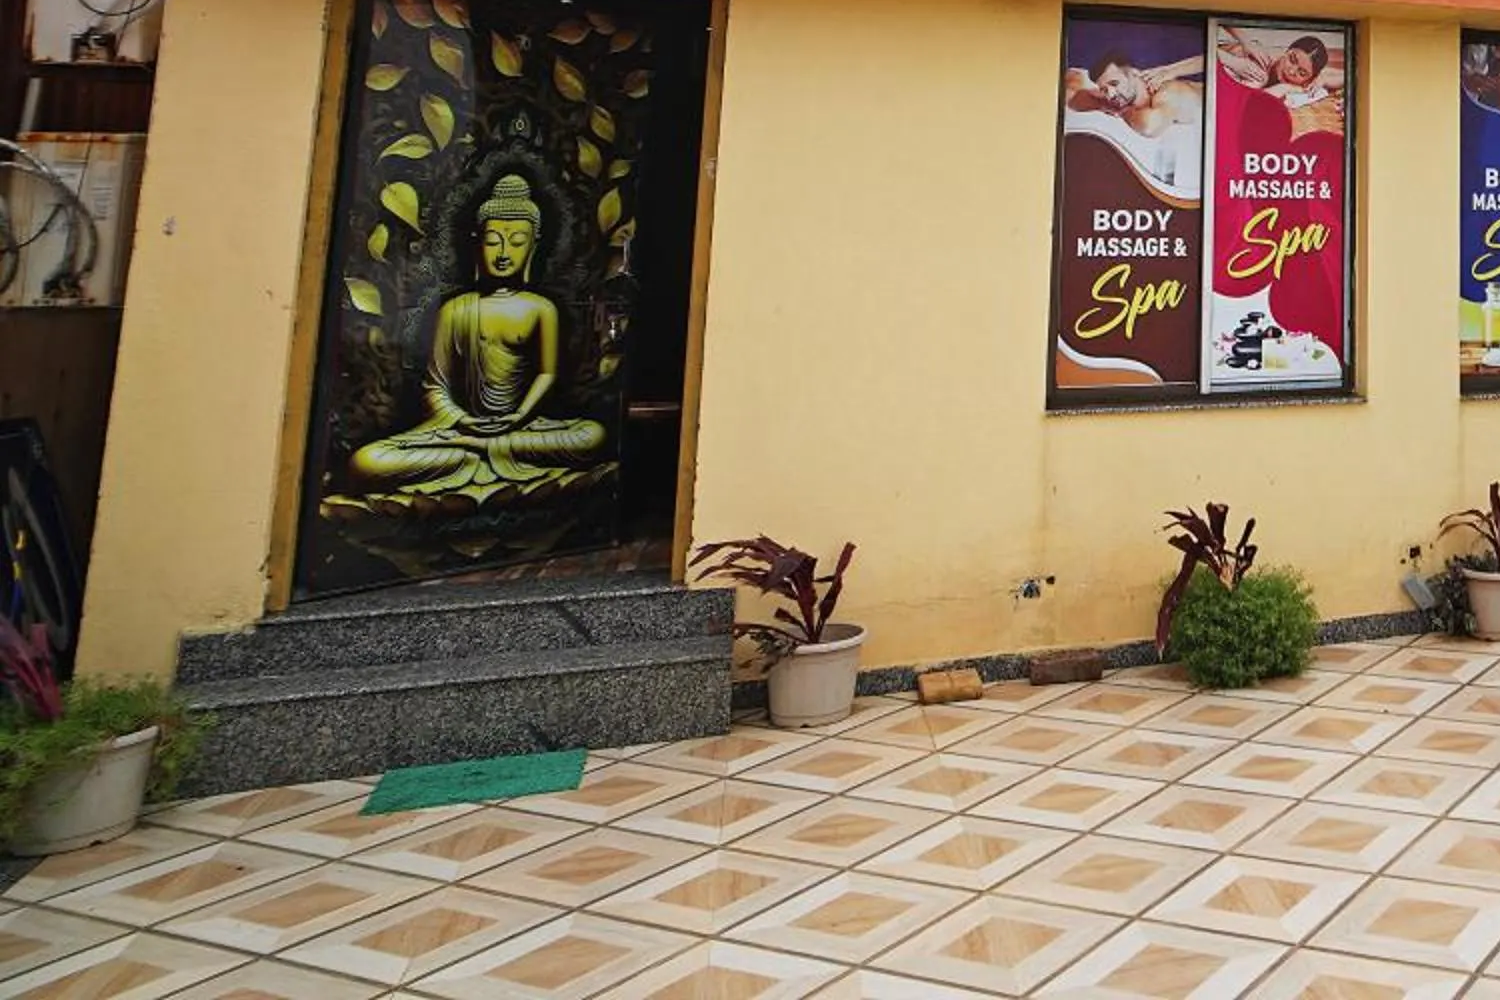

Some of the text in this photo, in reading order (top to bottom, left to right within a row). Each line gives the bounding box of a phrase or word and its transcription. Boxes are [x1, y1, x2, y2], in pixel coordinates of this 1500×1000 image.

[1244, 153, 1319, 175] BODY
[1229, 180, 1332, 200] MASSAGE &
[1093, 210, 1173, 232] BODY
[1076, 237, 1188, 257] MASSAGE &
[1227, 207, 1331, 280] Spa
[1074, 263, 1187, 340] Spa
